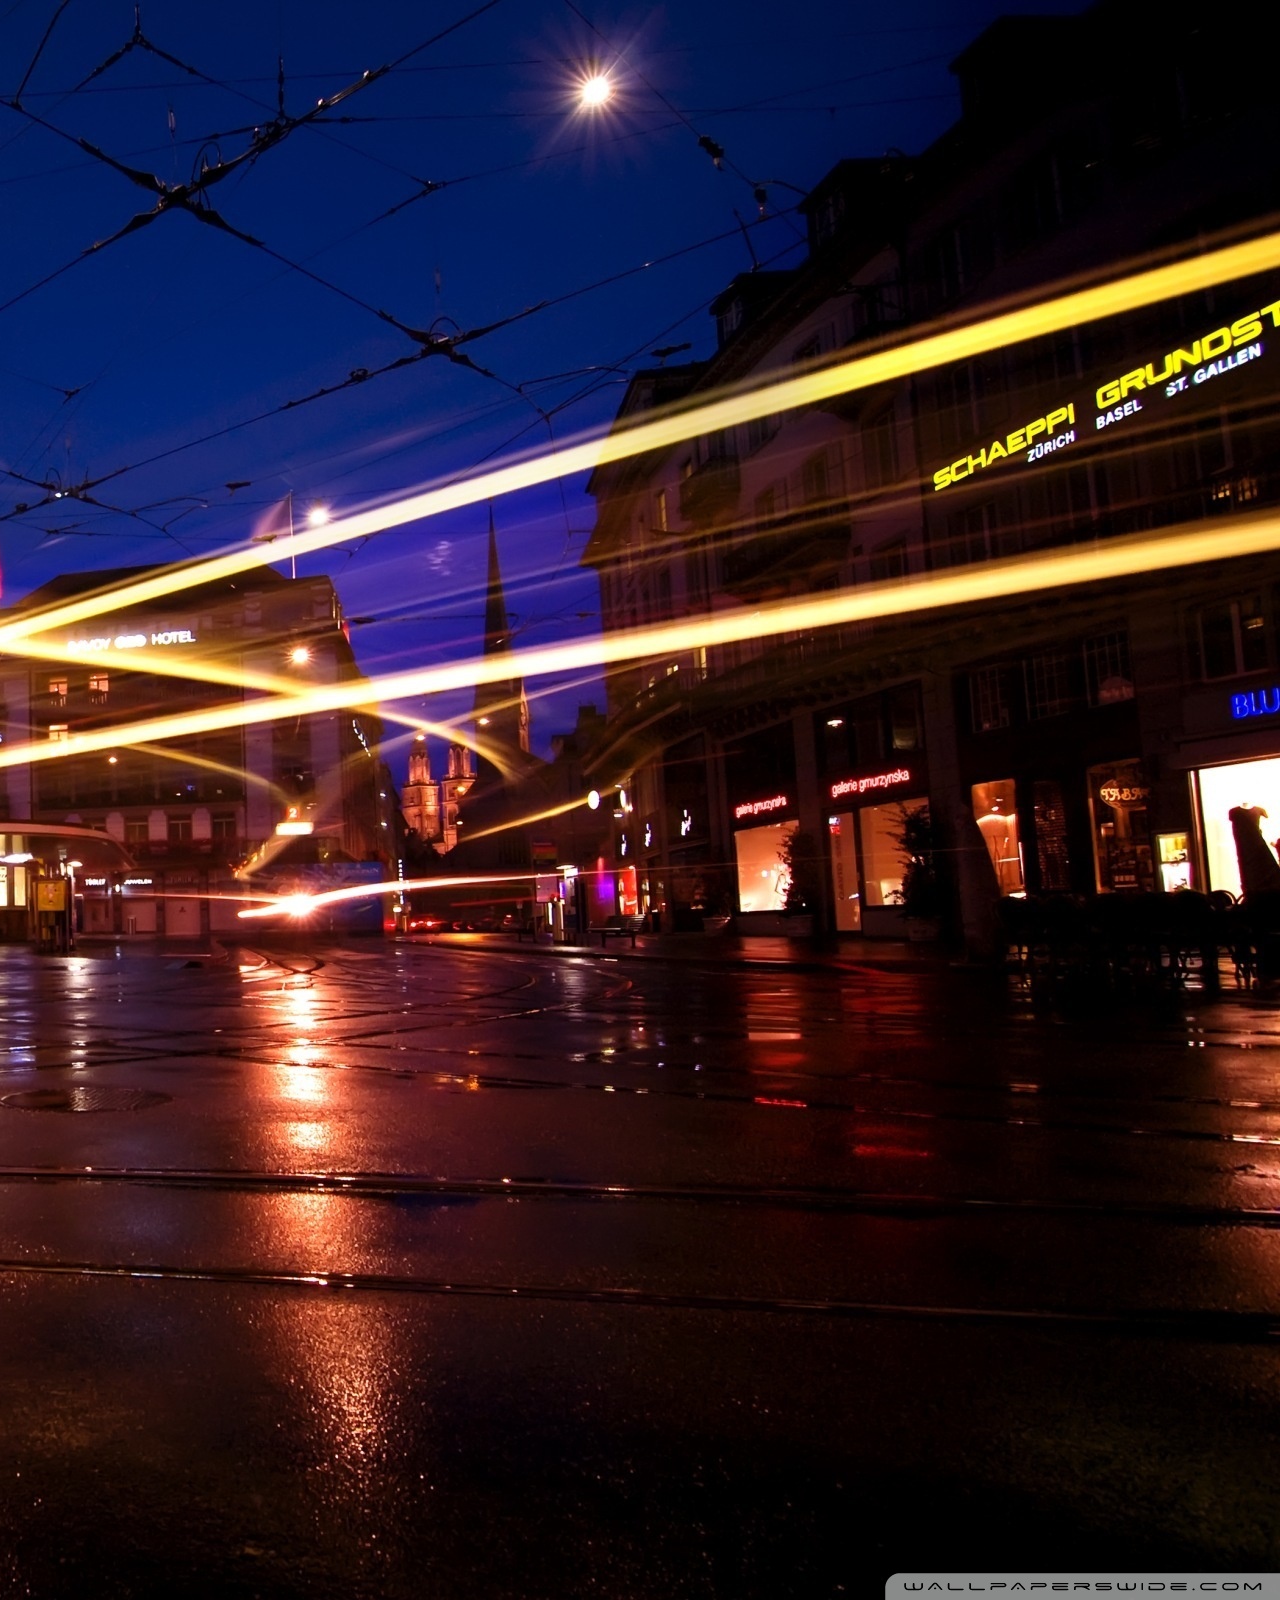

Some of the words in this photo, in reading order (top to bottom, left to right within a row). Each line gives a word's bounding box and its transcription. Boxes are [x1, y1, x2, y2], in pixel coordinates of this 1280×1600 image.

[1027, 430, 1075, 462] ZÜRICH
[1096, 399, 1143, 430] BASEL
[1166, 375, 1189, 398] ST.
[1194, 342, 1262, 386] GALLEN
[933, 403, 1075, 491] SCHAEPPI
[151, 630, 196, 645] HOTEL
[832, 778, 858, 797] galerie
[859, 769, 910, 792] gmurzynska
[1100, 787, 1150, 801] TABA
[288, 807, 298, 818] 2
